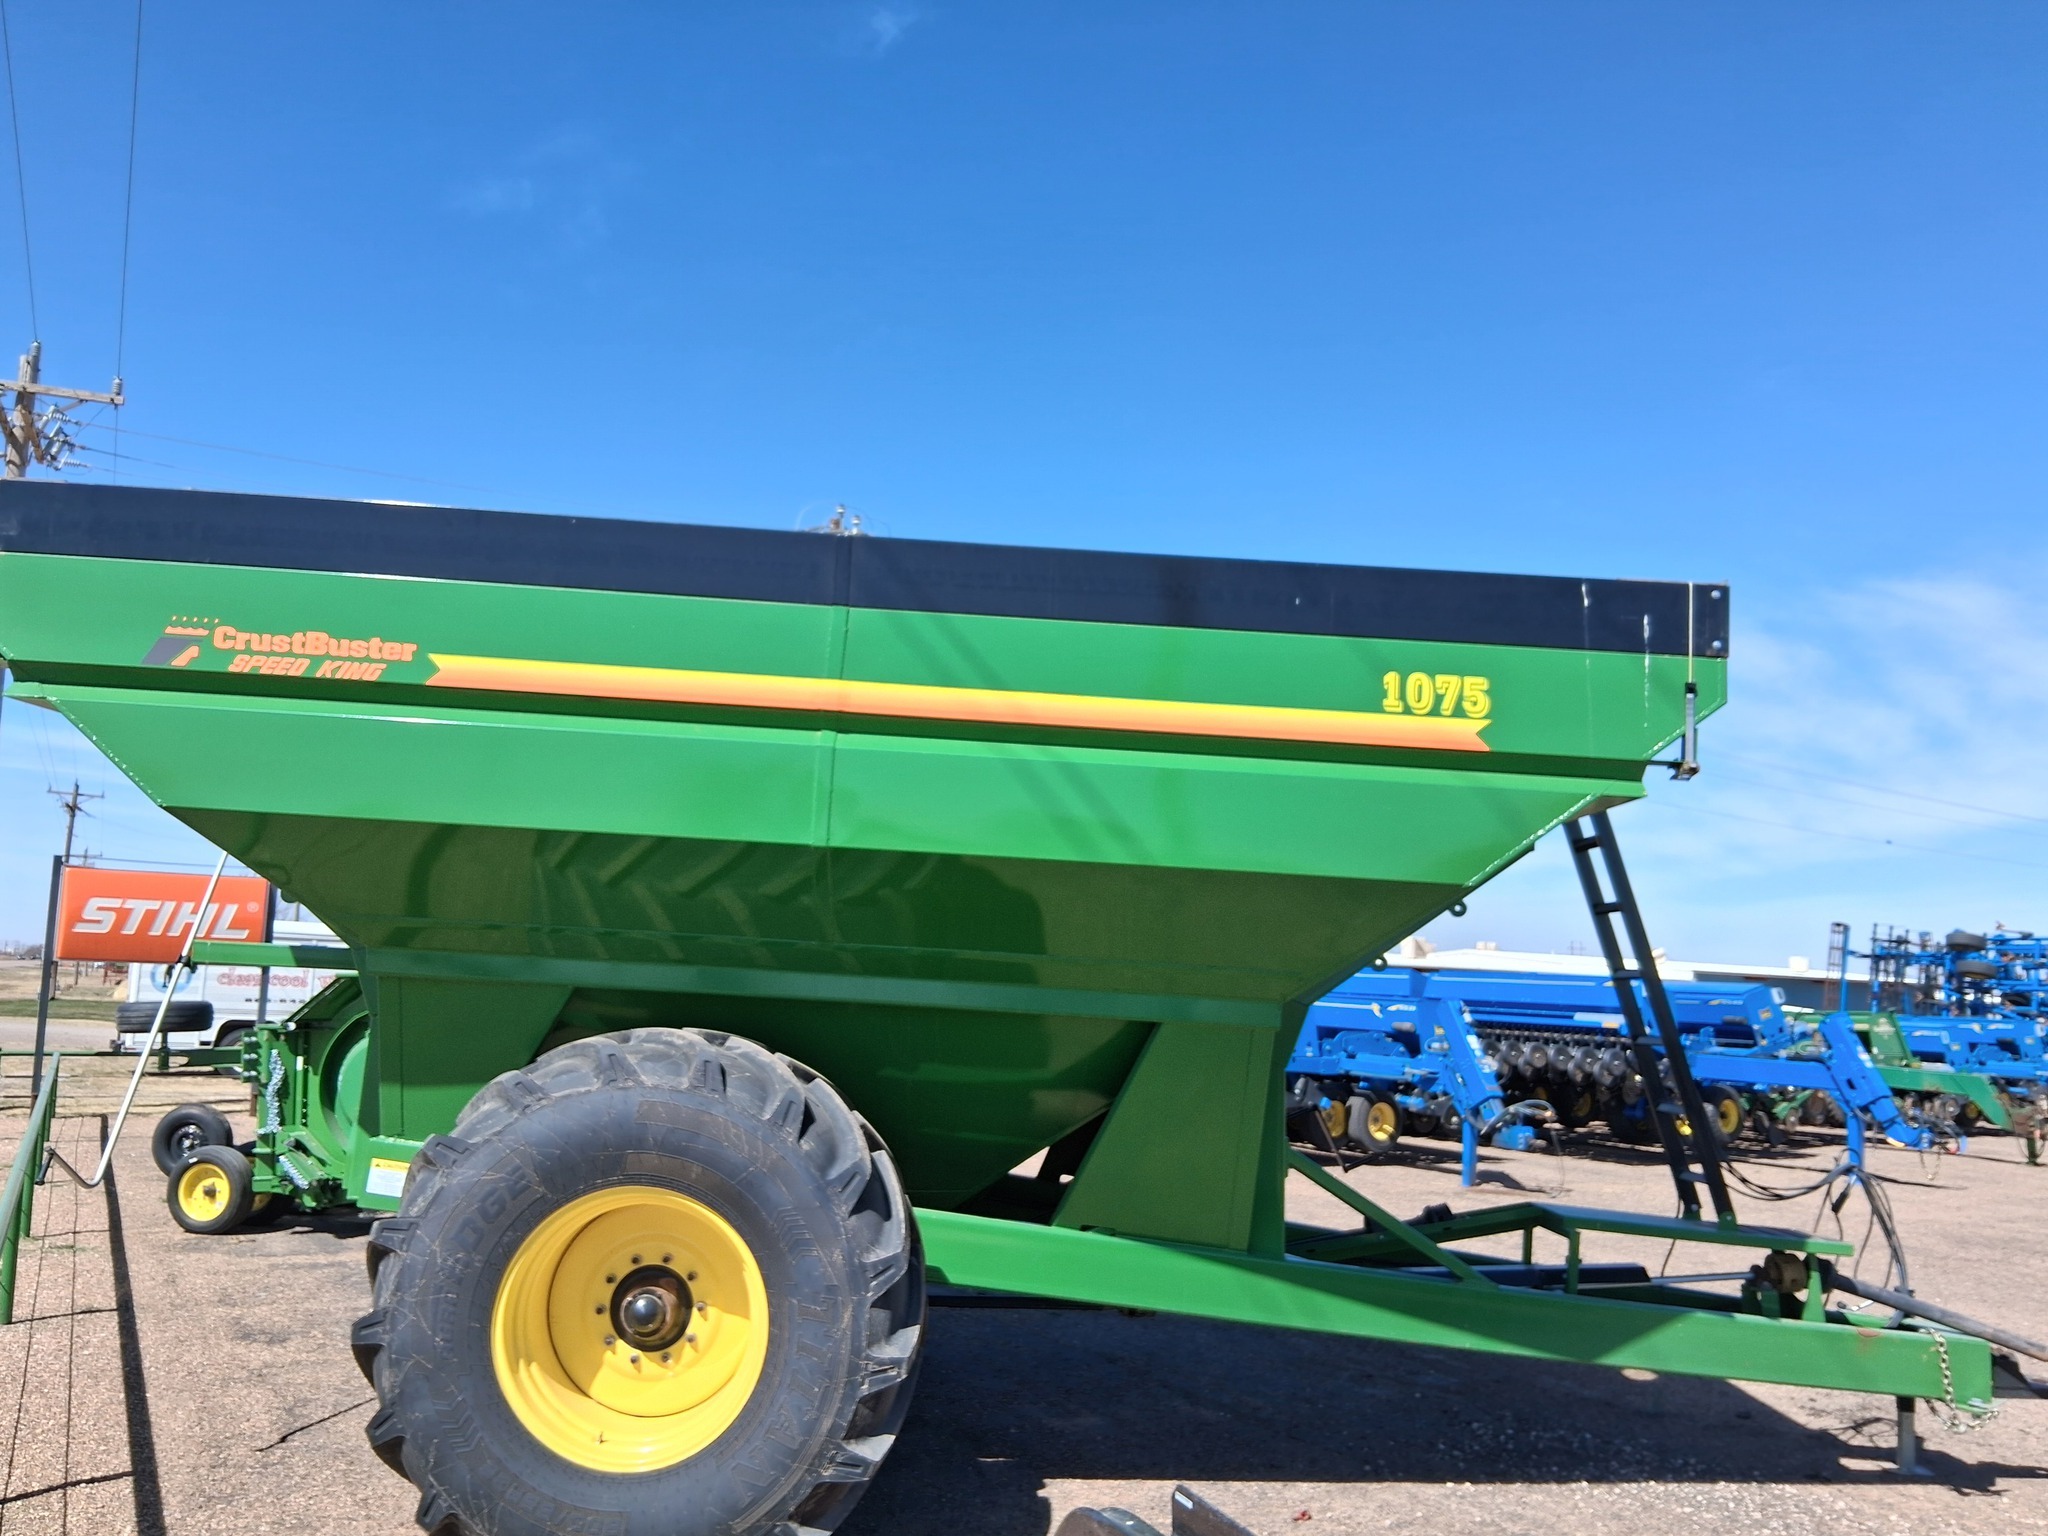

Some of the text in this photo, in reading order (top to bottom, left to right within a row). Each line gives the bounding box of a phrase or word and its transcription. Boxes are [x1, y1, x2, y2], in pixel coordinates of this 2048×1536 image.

[213, 625, 417, 662] CrustBuster
[228, 654, 387, 682] SPEED KING
[1382, 671, 1491, 718] 1075
[72, 897, 250, 940] STIHL
